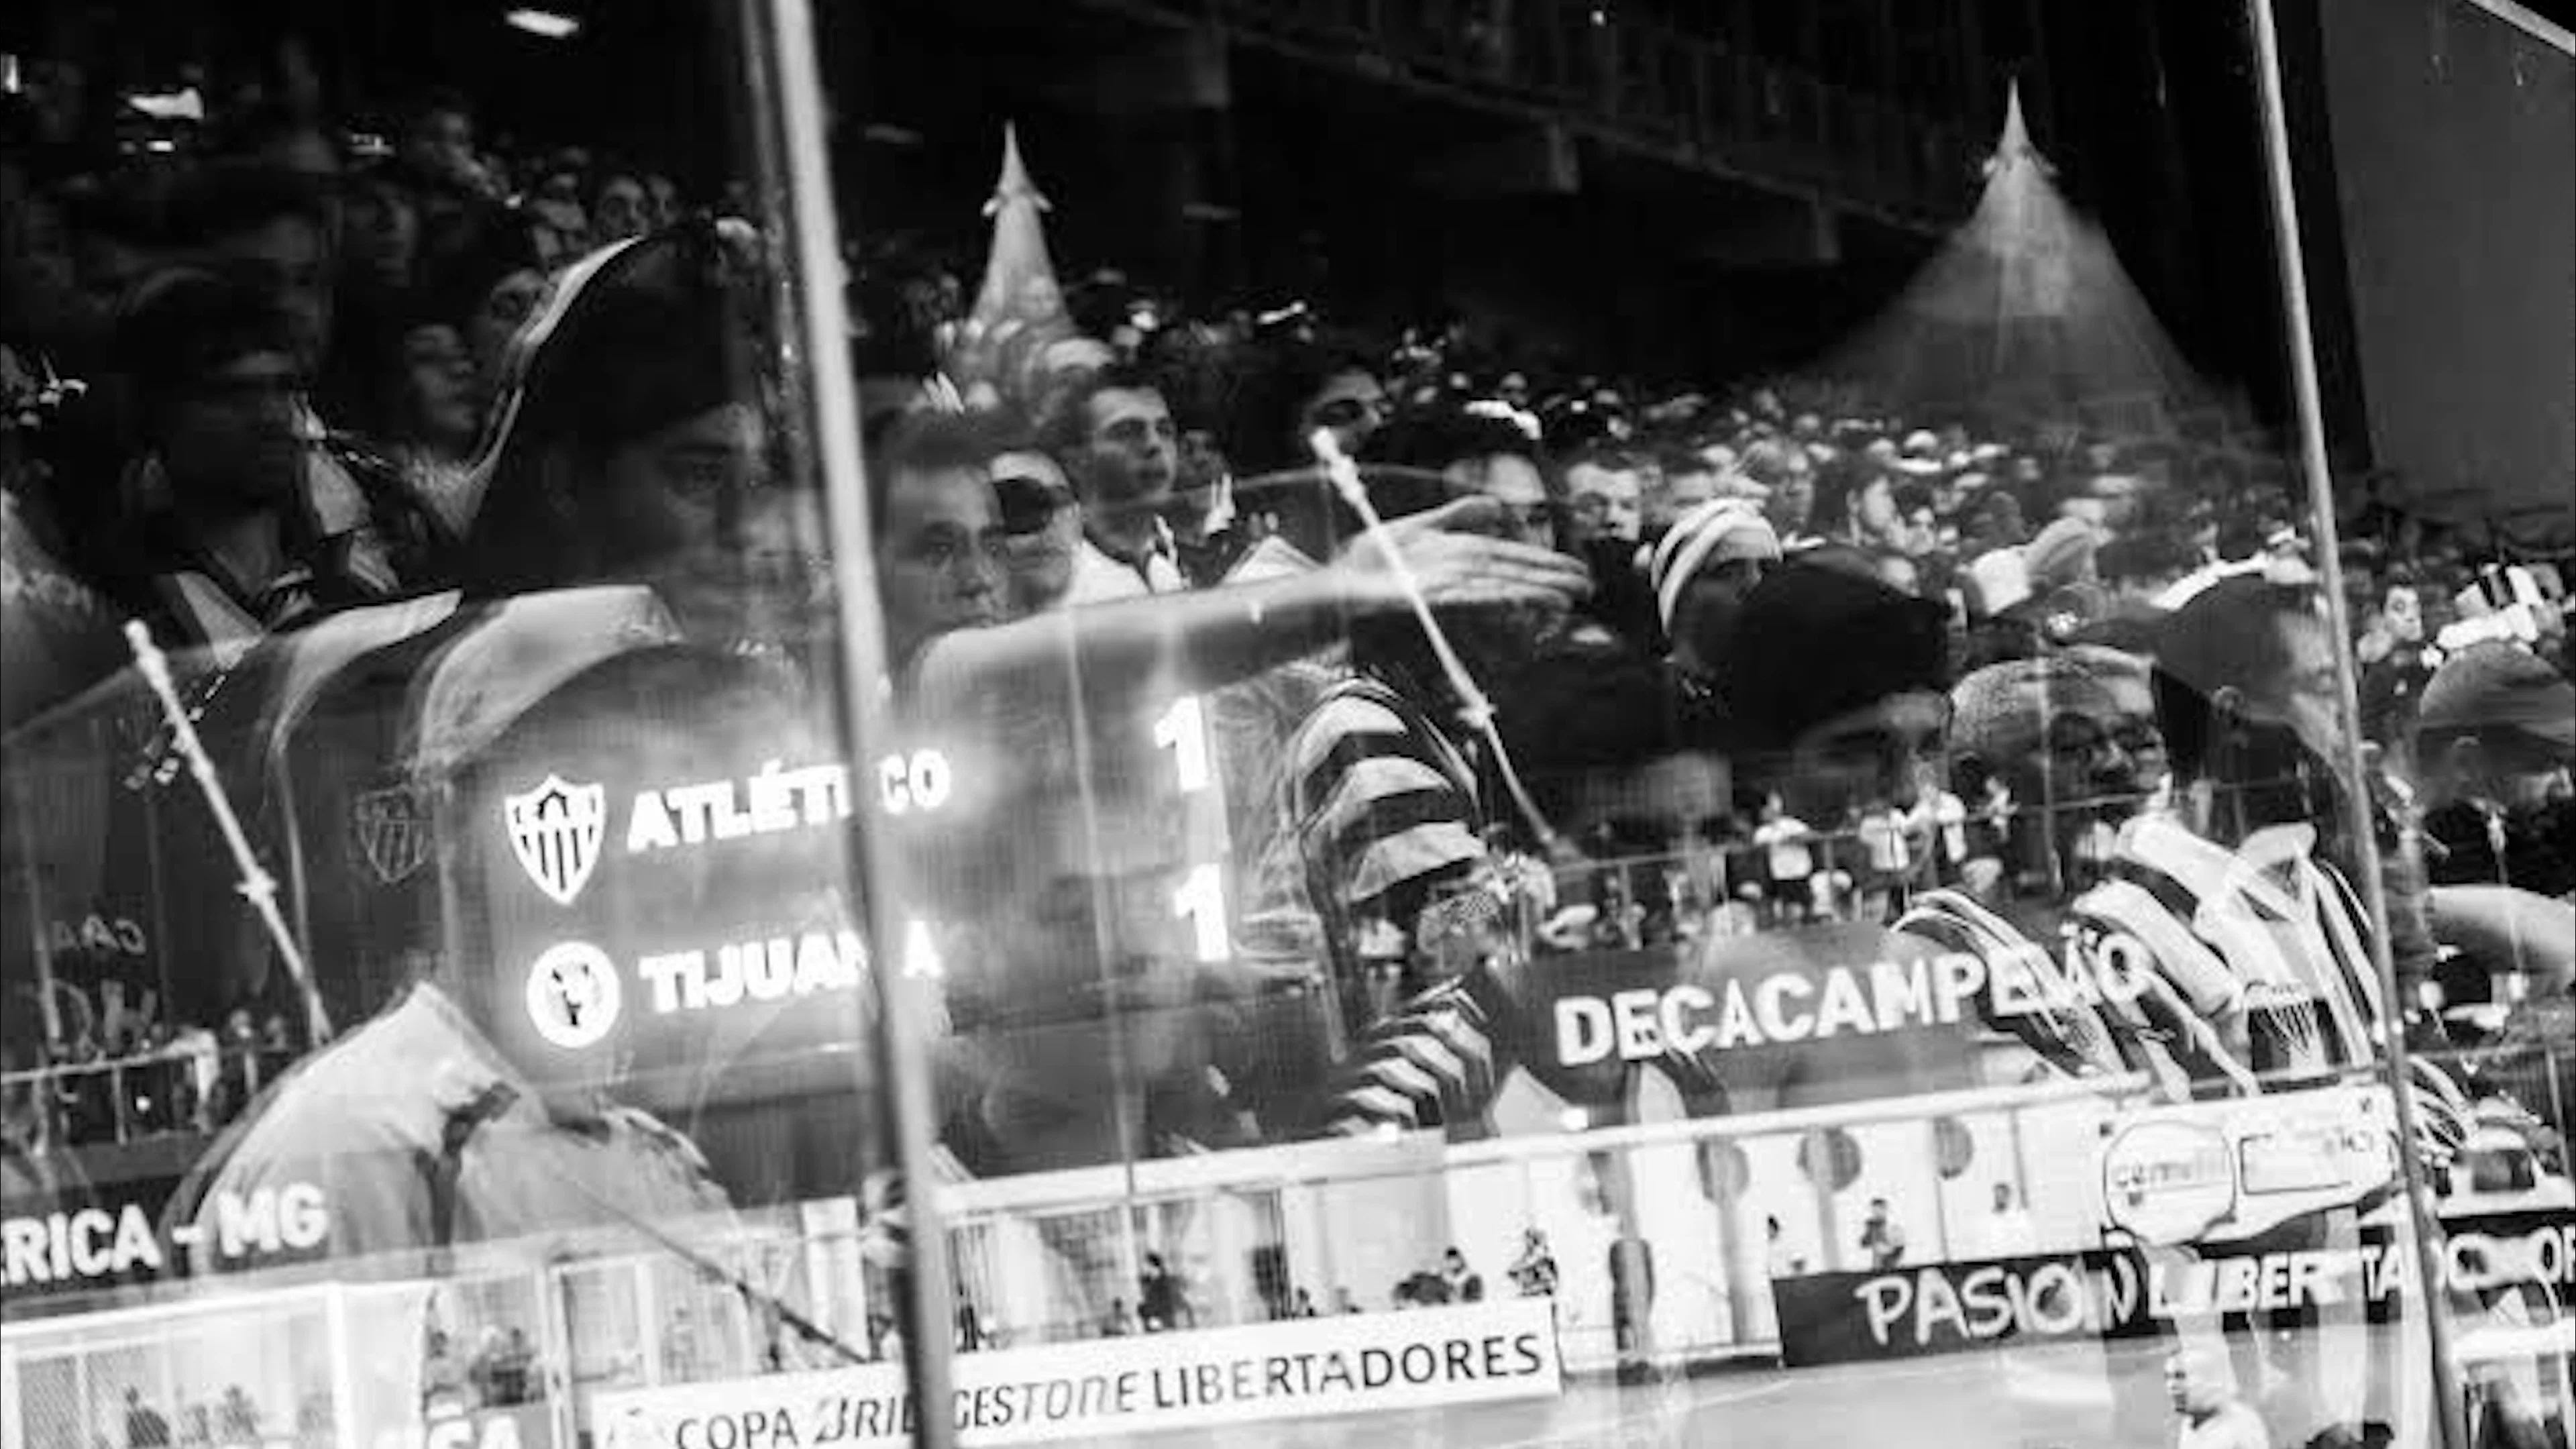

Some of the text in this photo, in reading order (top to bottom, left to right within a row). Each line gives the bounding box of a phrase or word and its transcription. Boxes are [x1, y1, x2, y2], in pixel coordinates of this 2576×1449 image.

[627, 696, 1209, 853] ATLÉTICO 1
[1174, 863, 1230, 964] 1
[0, 1203, 163, 1285] RICA
[217, 1181, 328, 1258] MG
[676, 1406, 801, 1449] COPA
[1151, 1332, 1544, 1412] LIBERTADORES
